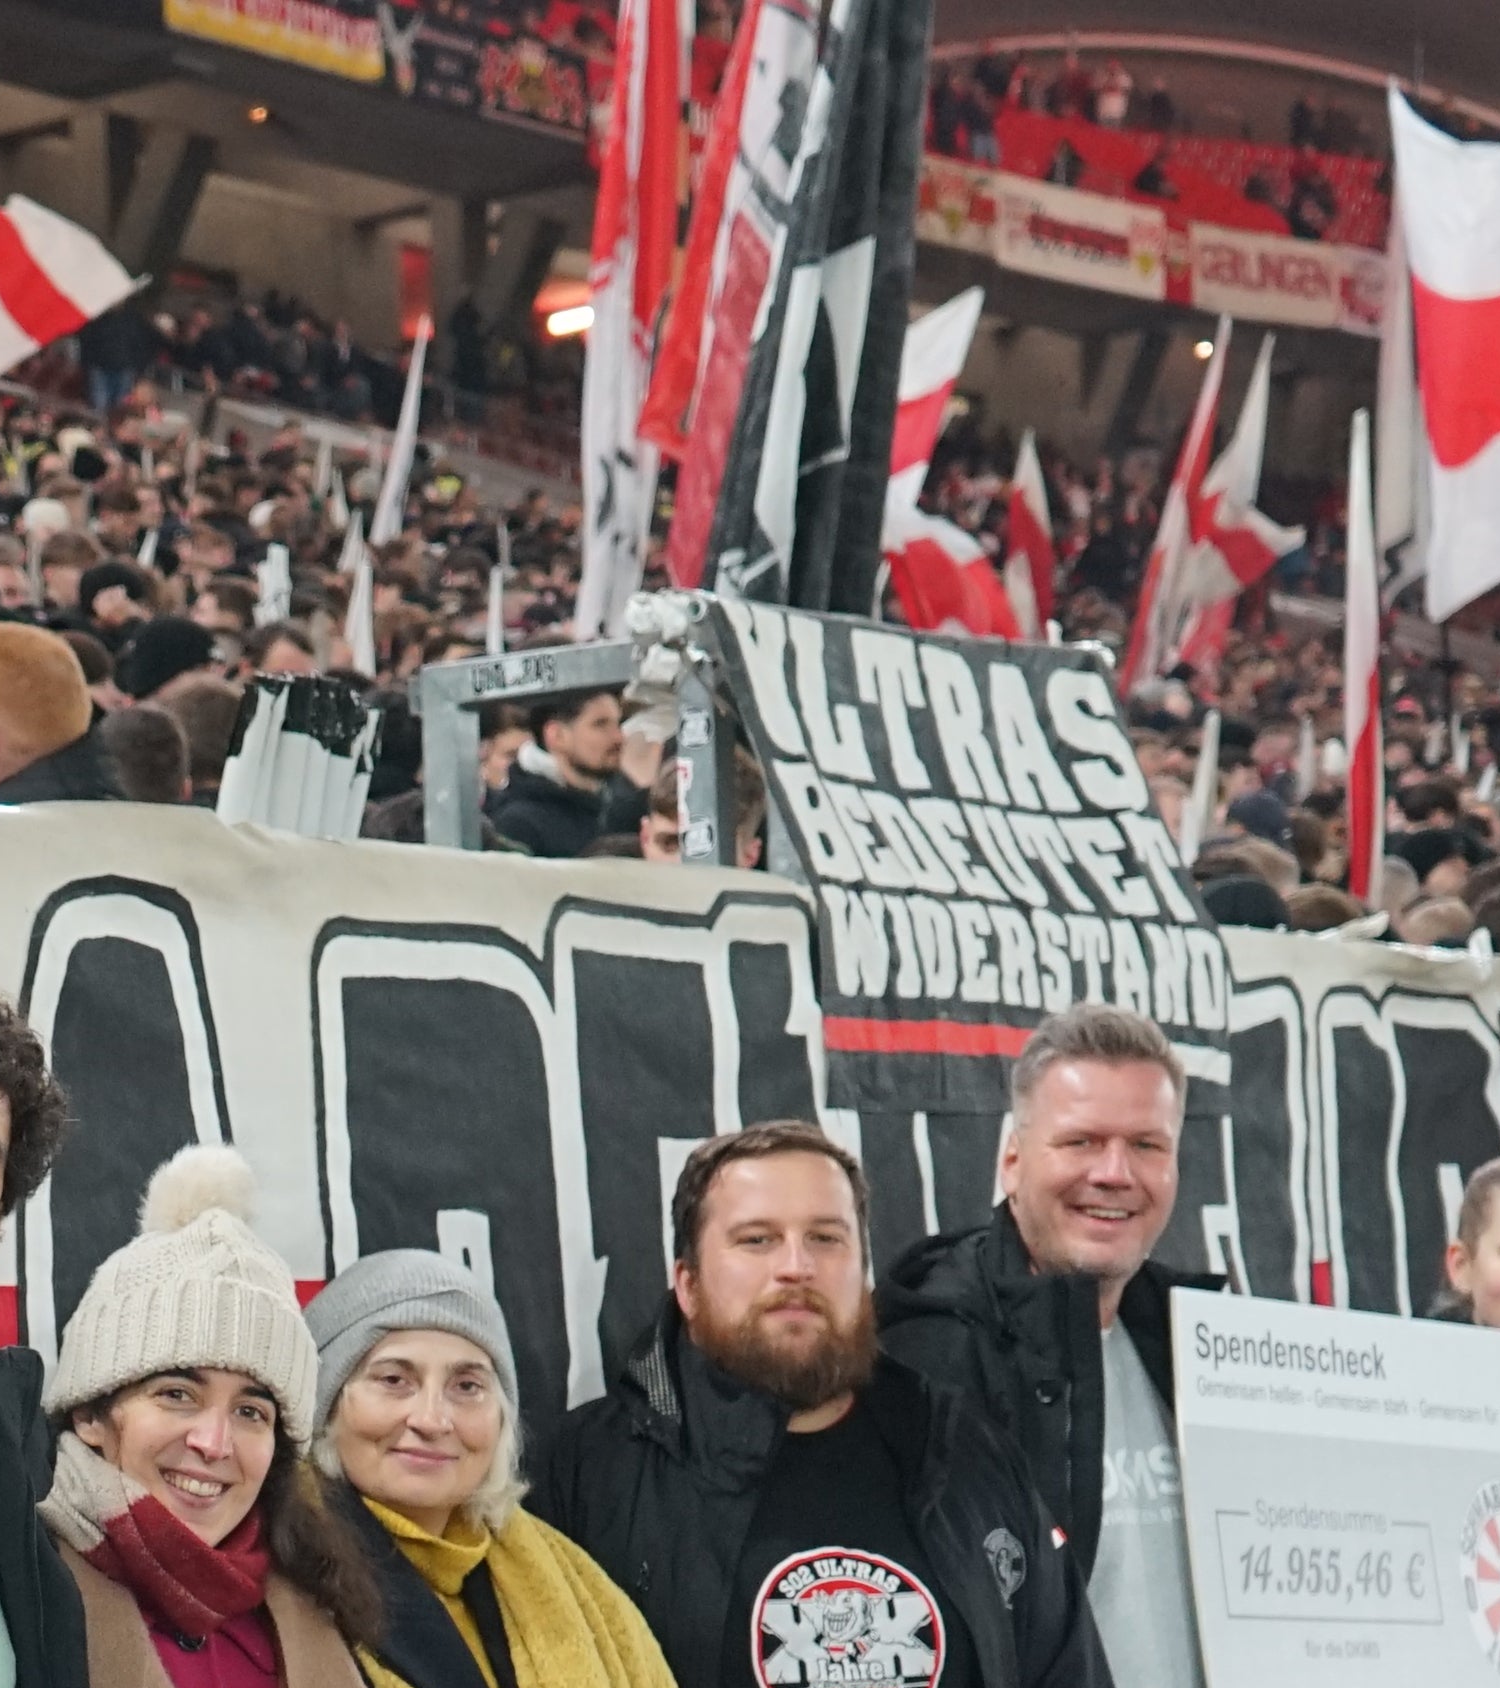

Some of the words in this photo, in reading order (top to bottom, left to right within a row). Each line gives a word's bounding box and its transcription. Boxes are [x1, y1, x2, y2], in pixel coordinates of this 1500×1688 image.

[732, 601, 1149, 813] ULTRAS
[775, 759, 1199, 922] BEDEUTET
[825, 889, 1231, 1031] WIDERSTAND
[1195, 1322, 1388, 1380] Spendenscheck
[1196, 1376, 1267, 1401] Gemeinsam
[1255, 1500, 1388, 1534] Spendensumme
[812, 1557, 901, 1594] ULTRAS
[1239, 1545, 1393, 1604] 14.955,46
[1406, 1552, 1427, 1599] €
